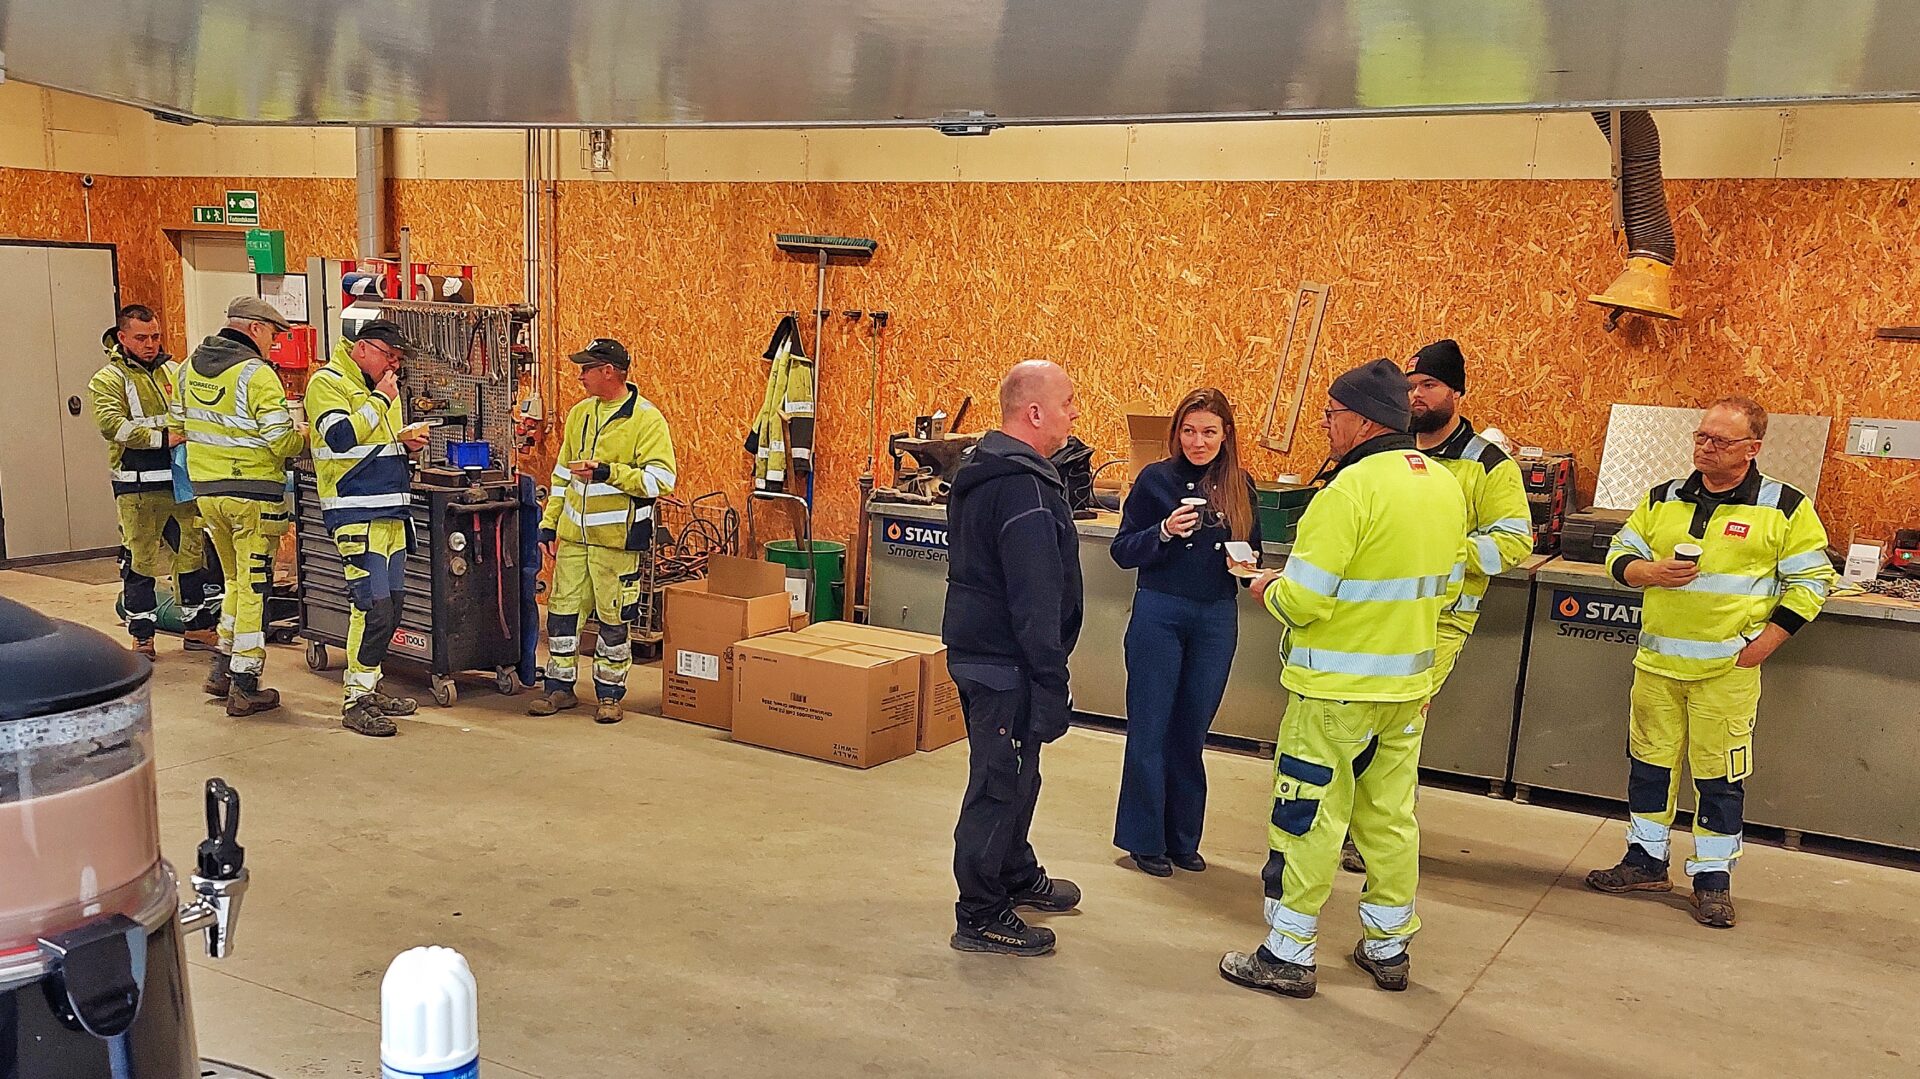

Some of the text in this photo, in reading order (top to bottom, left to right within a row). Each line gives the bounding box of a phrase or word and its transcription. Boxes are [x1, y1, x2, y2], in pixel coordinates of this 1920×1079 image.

[405, 634, 425, 648] TOOLS
[833, 743, 852, 753] WHIZ
[833, 751, 858, 761] WALLY
